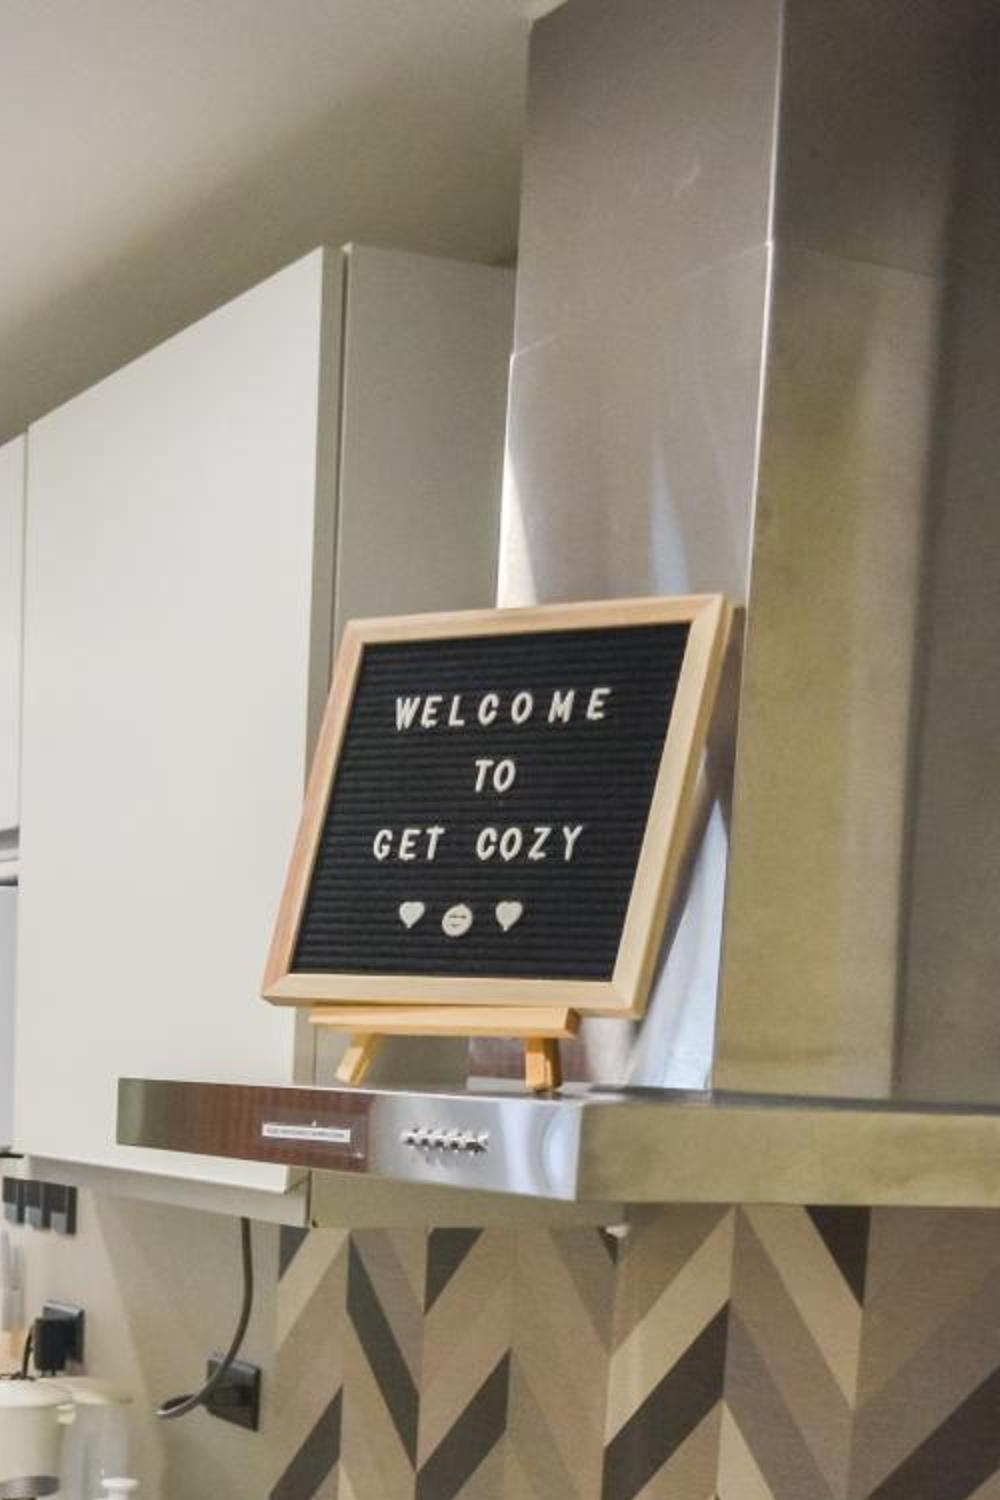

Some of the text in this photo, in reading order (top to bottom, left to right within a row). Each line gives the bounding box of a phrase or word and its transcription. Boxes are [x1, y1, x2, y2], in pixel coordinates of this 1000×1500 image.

[395, 687, 611, 731] WELCOME
[475, 759, 516, 793] TO
[373, 825, 583, 862] GET COZY
